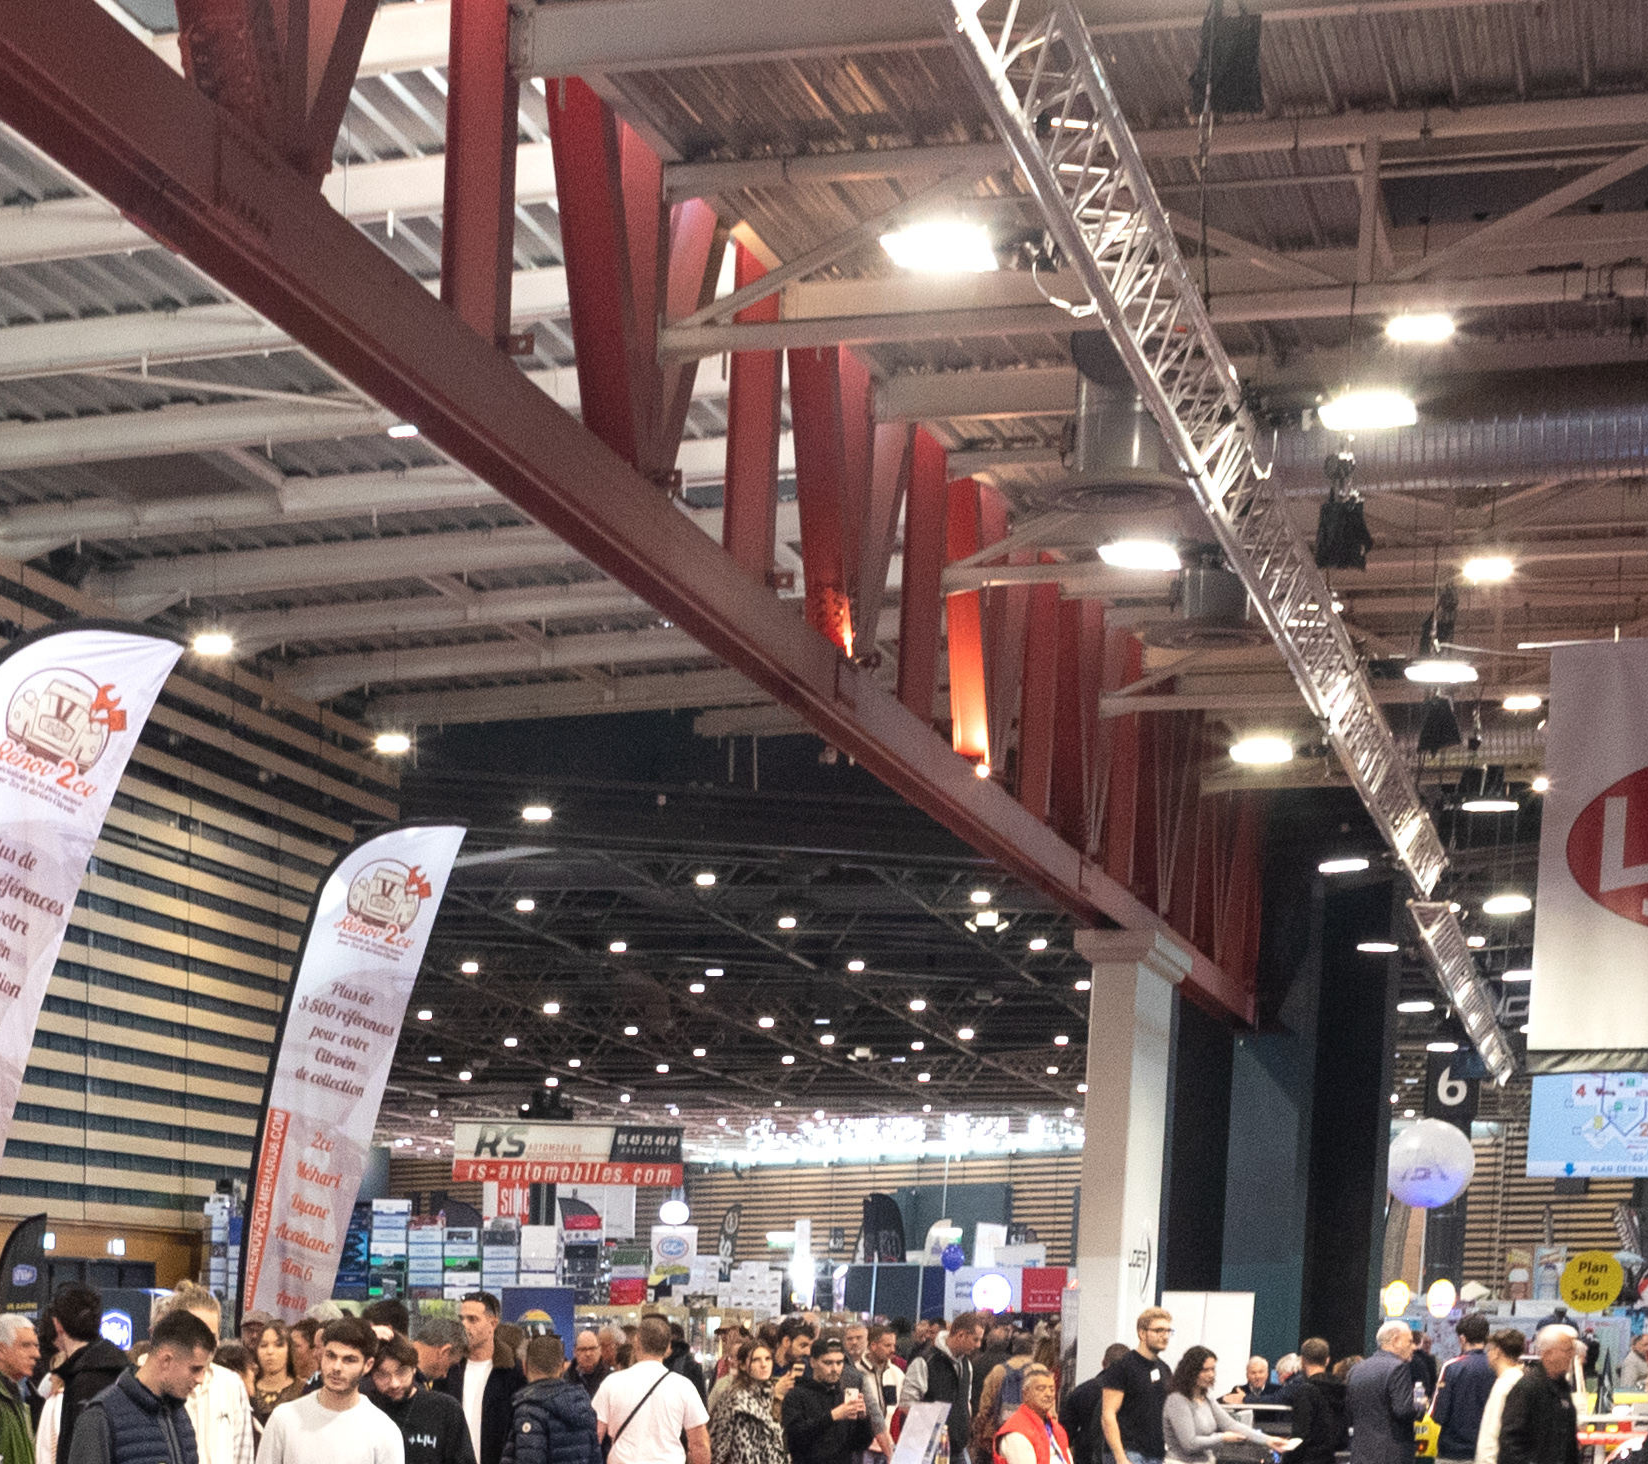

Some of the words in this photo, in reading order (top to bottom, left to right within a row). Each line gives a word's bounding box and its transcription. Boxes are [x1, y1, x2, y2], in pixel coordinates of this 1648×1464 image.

[18, 853, 38, 874] de
[310, 1000, 337, 1020] 500
[310, 1072, 364, 1098] collection
[1438, 1066, 1468, 1106] 6
[473, 1125, 529, 1158] RS
[467, 1162, 672, 1184] rs-automobiles.com
[1577, 1262, 1608, 1275] Plan
[1584, 1276, 1599, 1287] du
[1570, 1289, 1609, 1301] Salon
